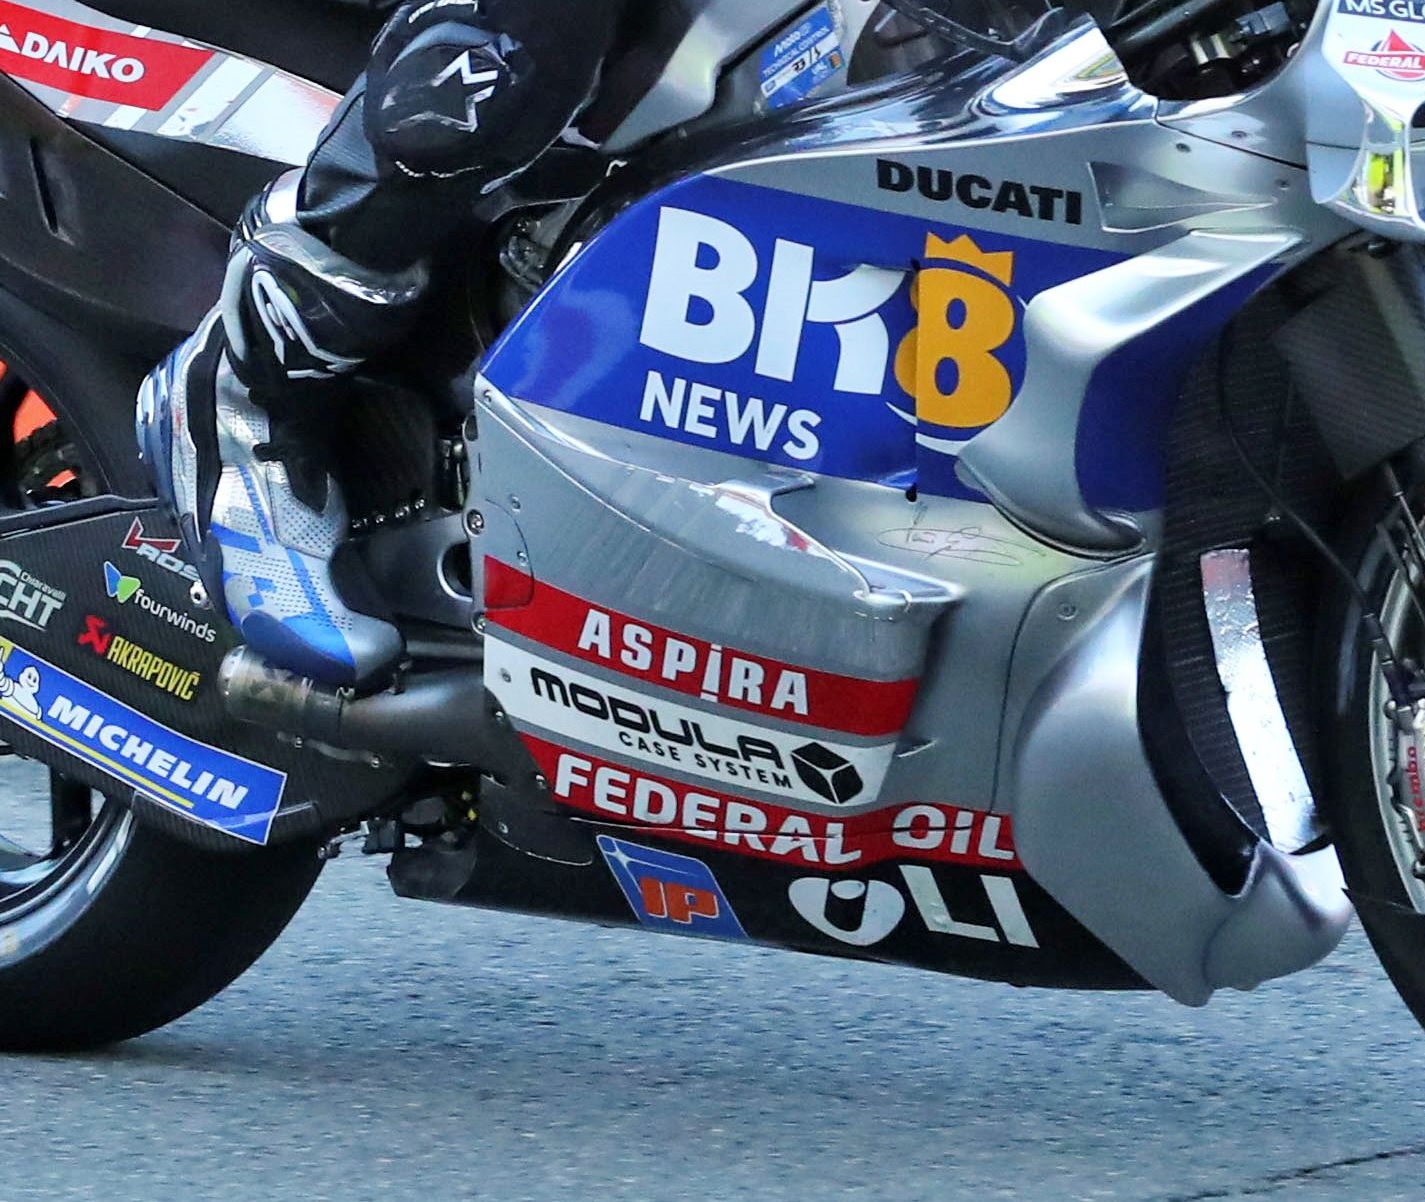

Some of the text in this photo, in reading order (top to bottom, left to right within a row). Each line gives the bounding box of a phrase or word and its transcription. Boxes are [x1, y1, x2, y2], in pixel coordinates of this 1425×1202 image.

[18, 30, 146, 85] DAIKO
[1346, 53, 1425, 70] FEDERAL
[875, 158, 1082, 226] DUCATI
[638, 204, 1017, 429] BK8
[638, 368, 823, 462] NEWS
[133, 588, 218, 644] fourwinds
[529, 666, 785, 770] MODULA
[46, 693, 250, 812] MICHELIN
[618, 730, 792, 790] CASE SYSTEM
[553, 753, 1017, 865] FEDERAL OIL
[638, 876, 720, 925] IP
